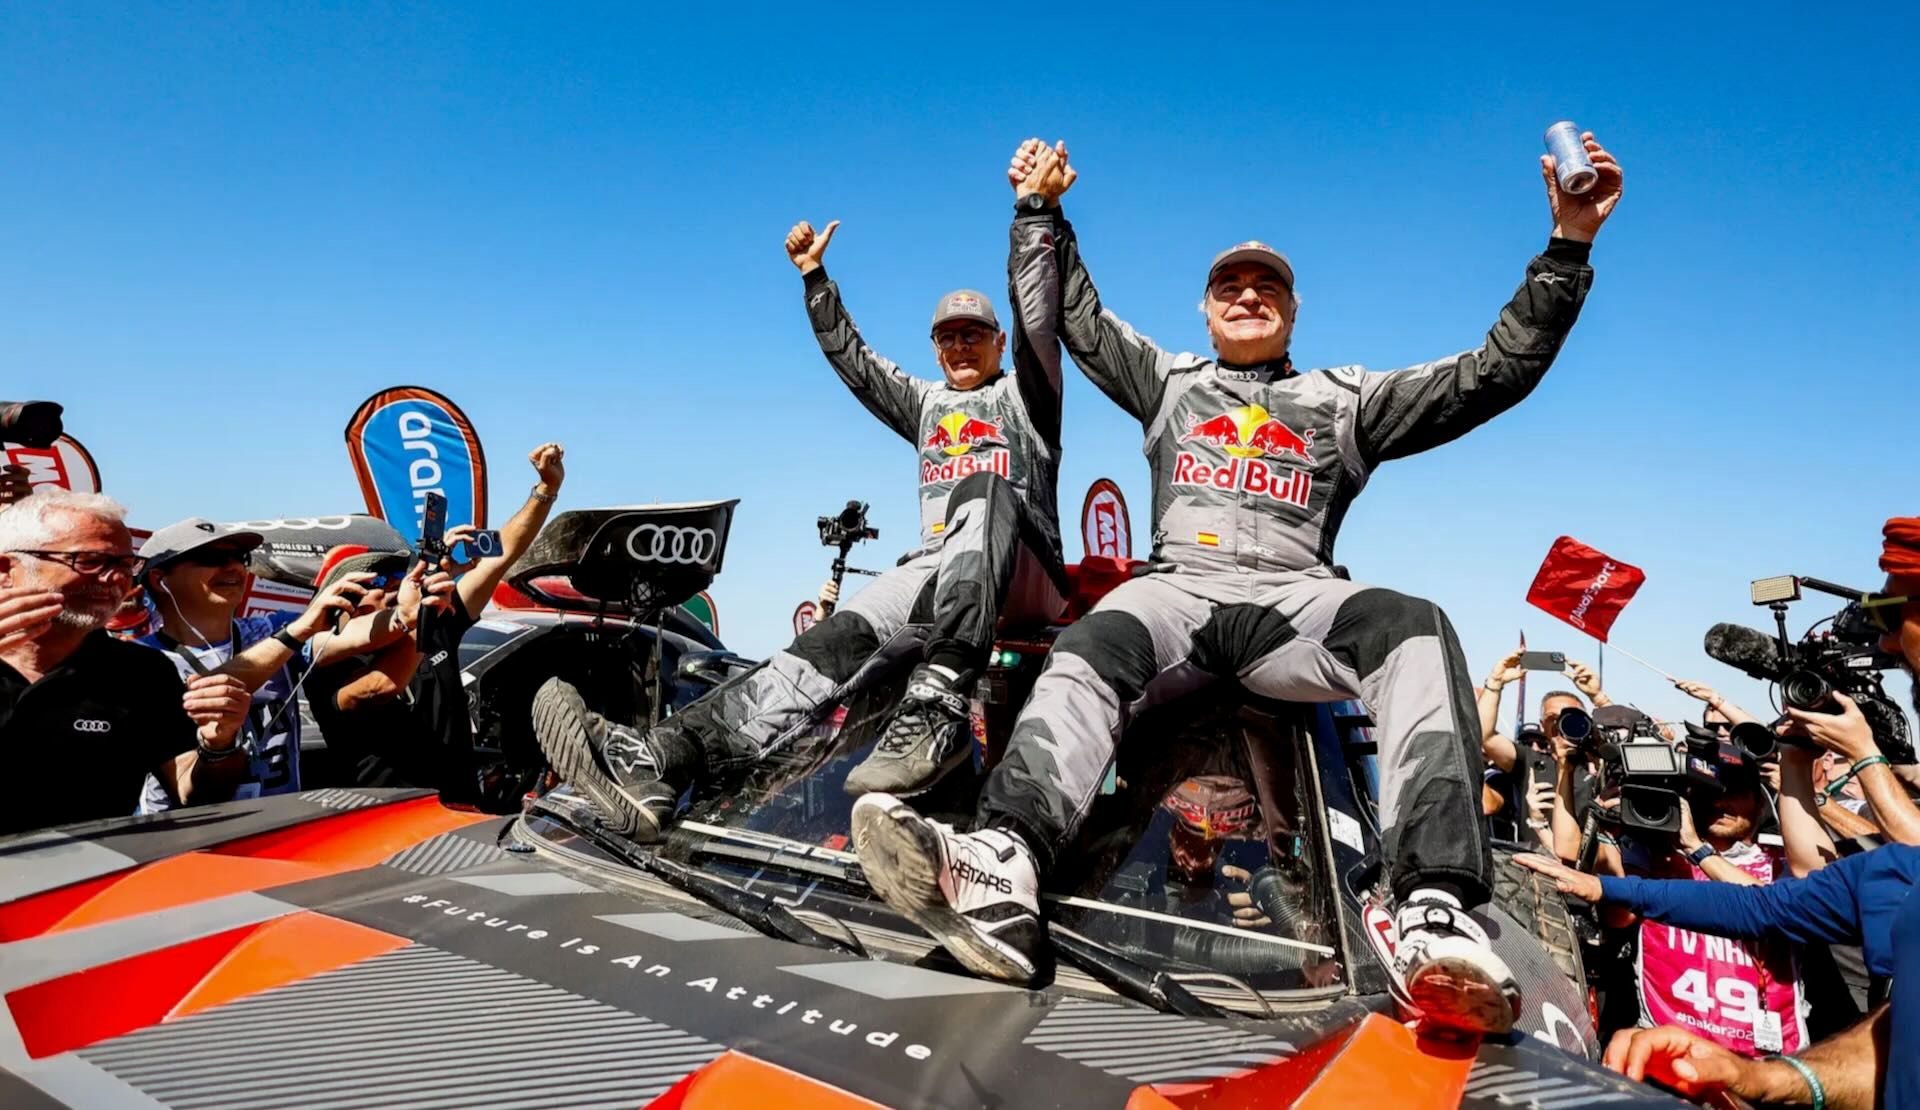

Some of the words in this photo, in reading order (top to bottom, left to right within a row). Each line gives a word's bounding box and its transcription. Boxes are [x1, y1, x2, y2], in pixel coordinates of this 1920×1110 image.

[922, 458, 956, 484] Red
[1172, 452, 1239, 493] Red
[1243, 459, 1312, 509] Bull
[1589, 561, 1616, 595] port
[402, 894, 548, 940] #Future
[559, 937, 600, 955] Is
[610, 954, 672, 977] An
[1671, 968, 1759, 1023] 49
[1676, 1011, 1755, 1041] #Dakar202
